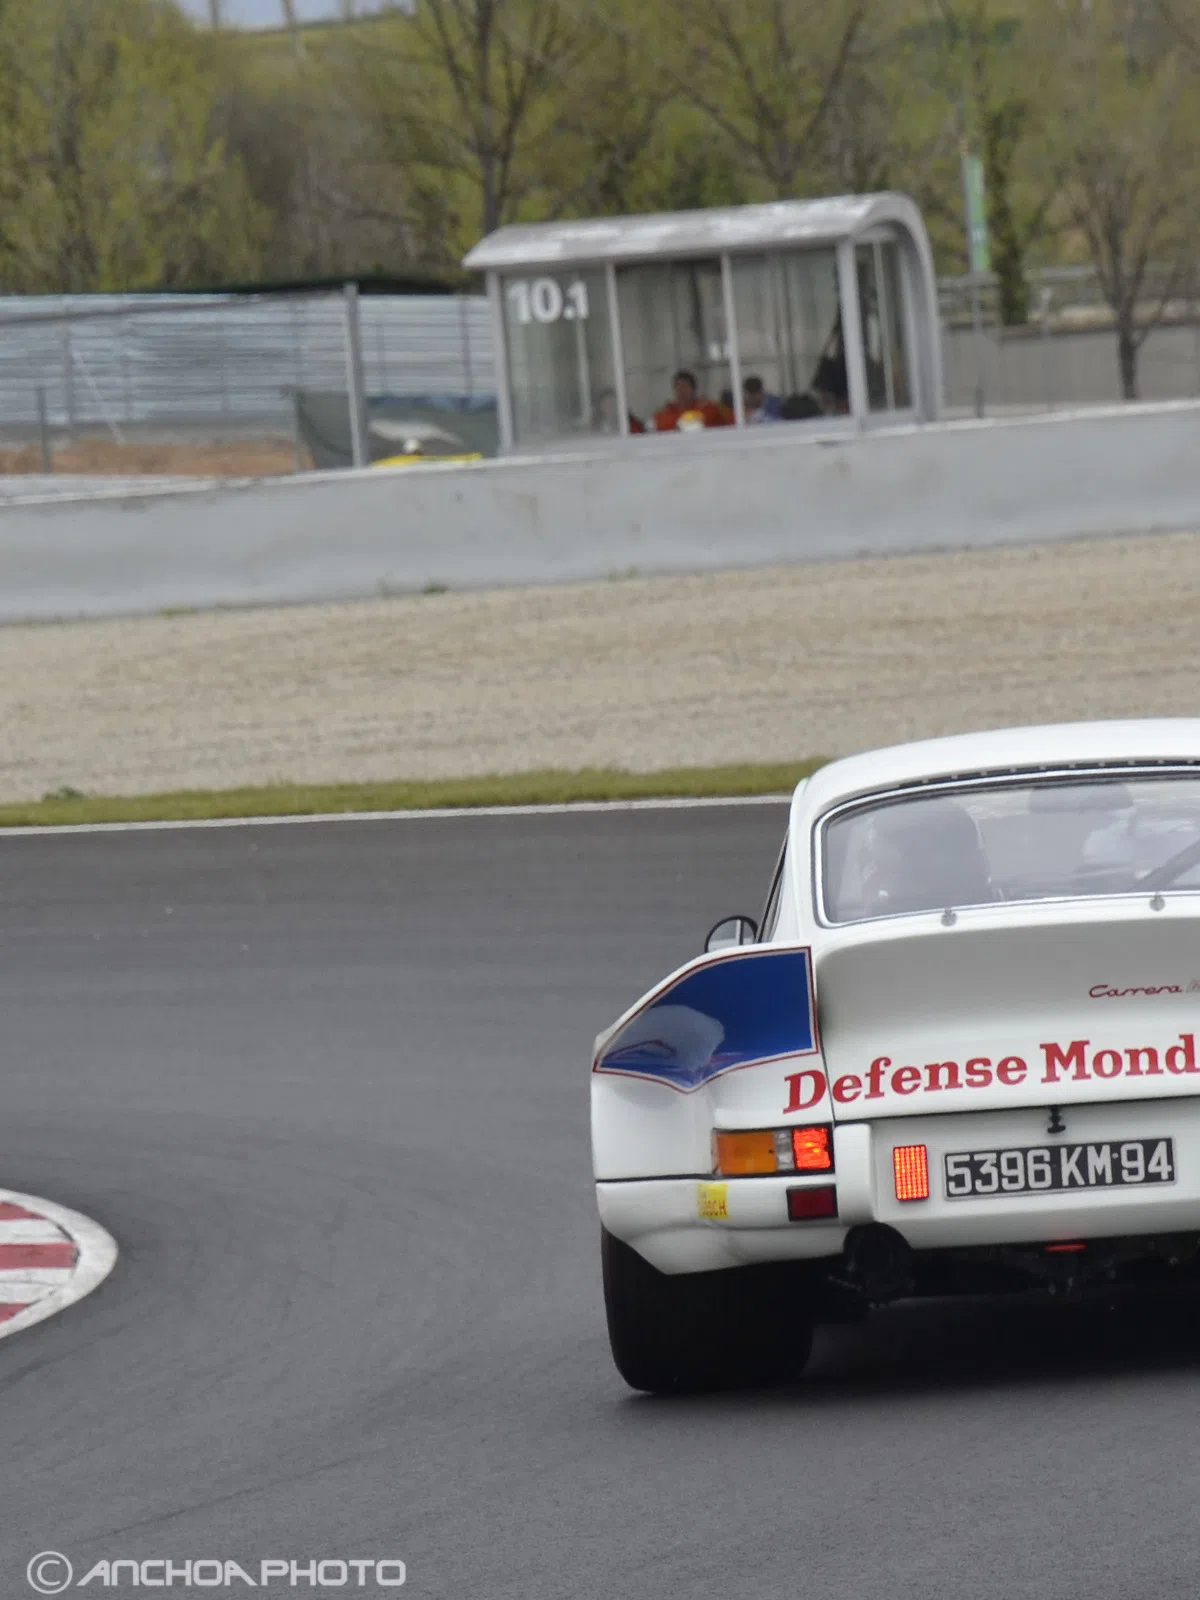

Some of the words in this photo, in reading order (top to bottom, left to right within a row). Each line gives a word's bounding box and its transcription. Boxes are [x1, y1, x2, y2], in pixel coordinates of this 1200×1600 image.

[506, 279, 588, 324] 10.1
[1088, 984, 1183, 998] Carrera
[782, 1056, 1028, 1114] Defense
[946, 1149, 1052, 1195] 5396
[1059, 1144, 1113, 1187] KM
[1120, 1140, 1173, 1183] 94
